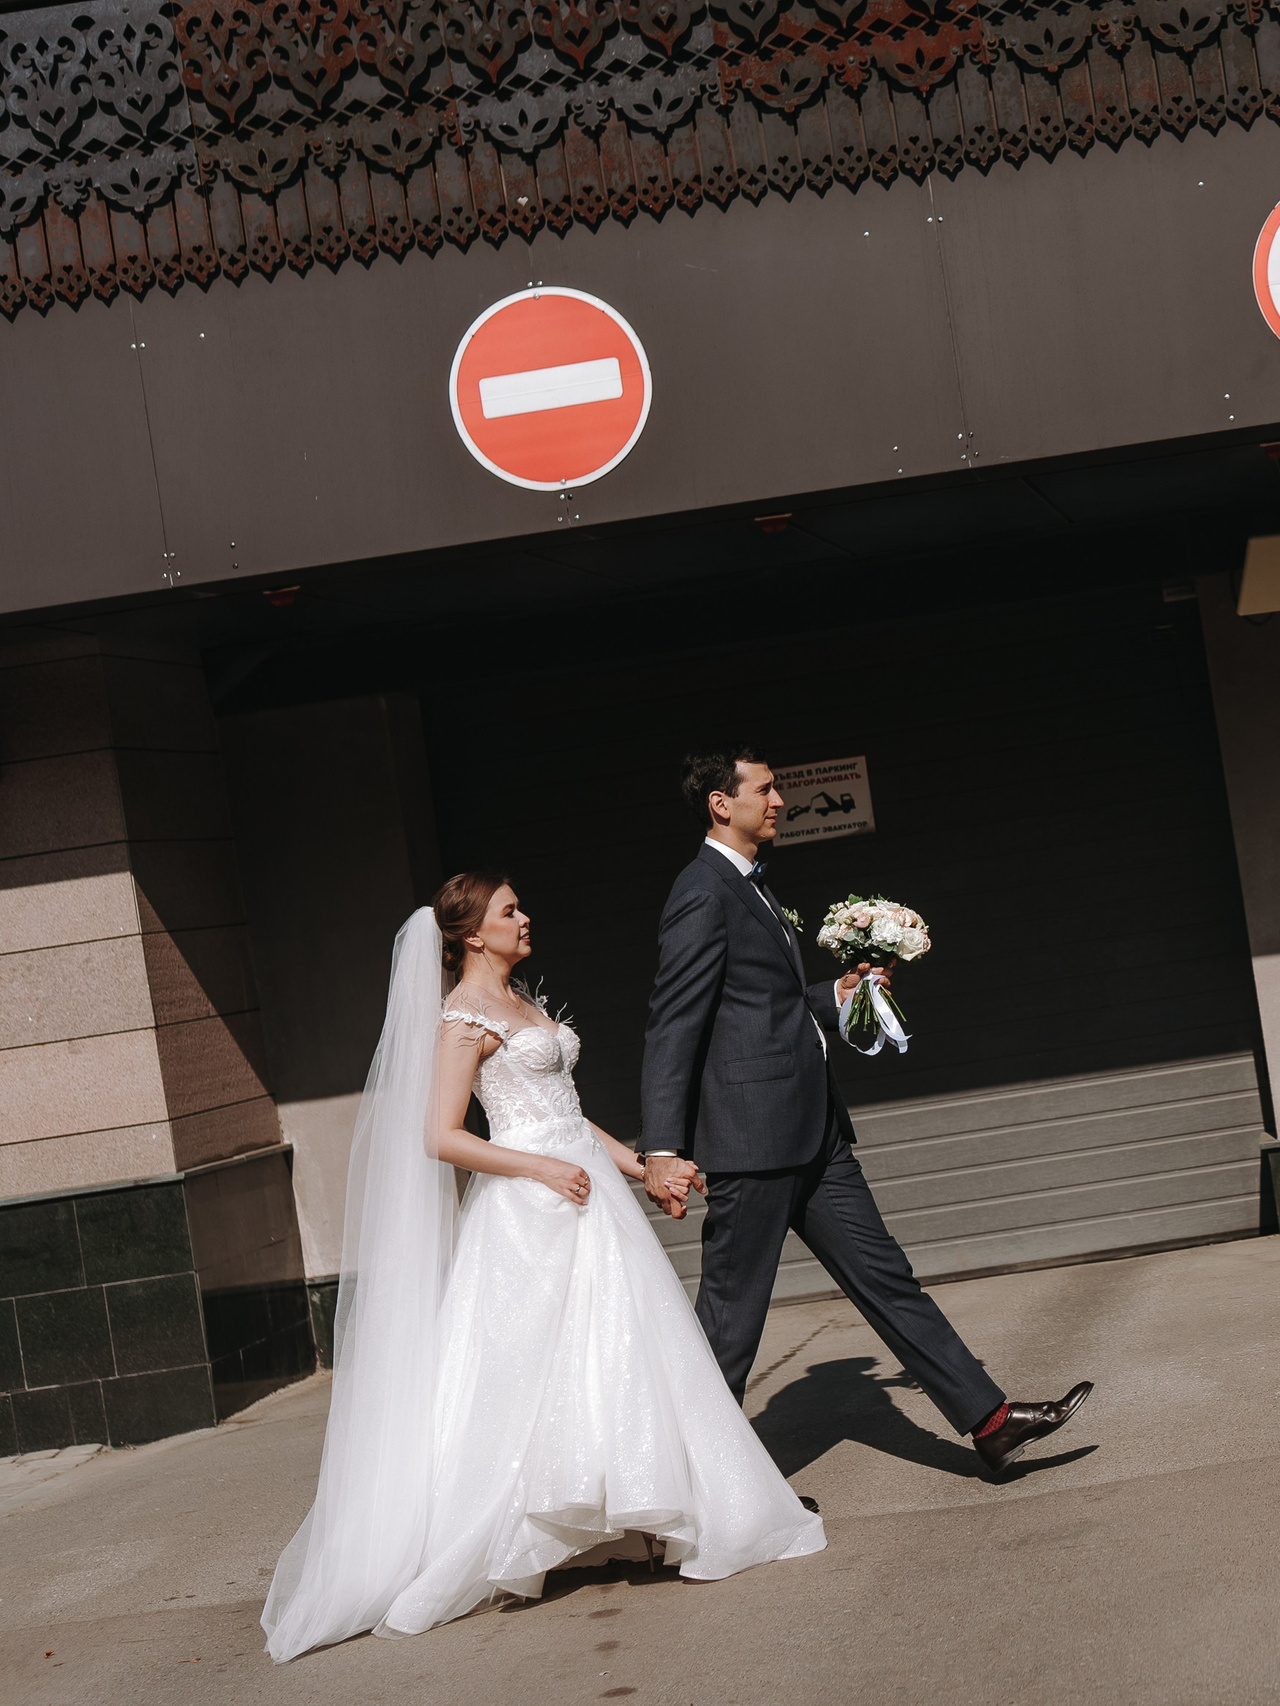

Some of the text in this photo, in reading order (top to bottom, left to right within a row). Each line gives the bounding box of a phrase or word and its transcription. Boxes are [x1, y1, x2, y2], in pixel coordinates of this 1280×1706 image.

[815, 763, 858, 775] ПАРКИНГ
[787, 773, 862, 790] ЗАГОРАЖИВАТЬ
[780, 821, 868, 839] РАБОТАЕТ ЭВАКУАТОР
